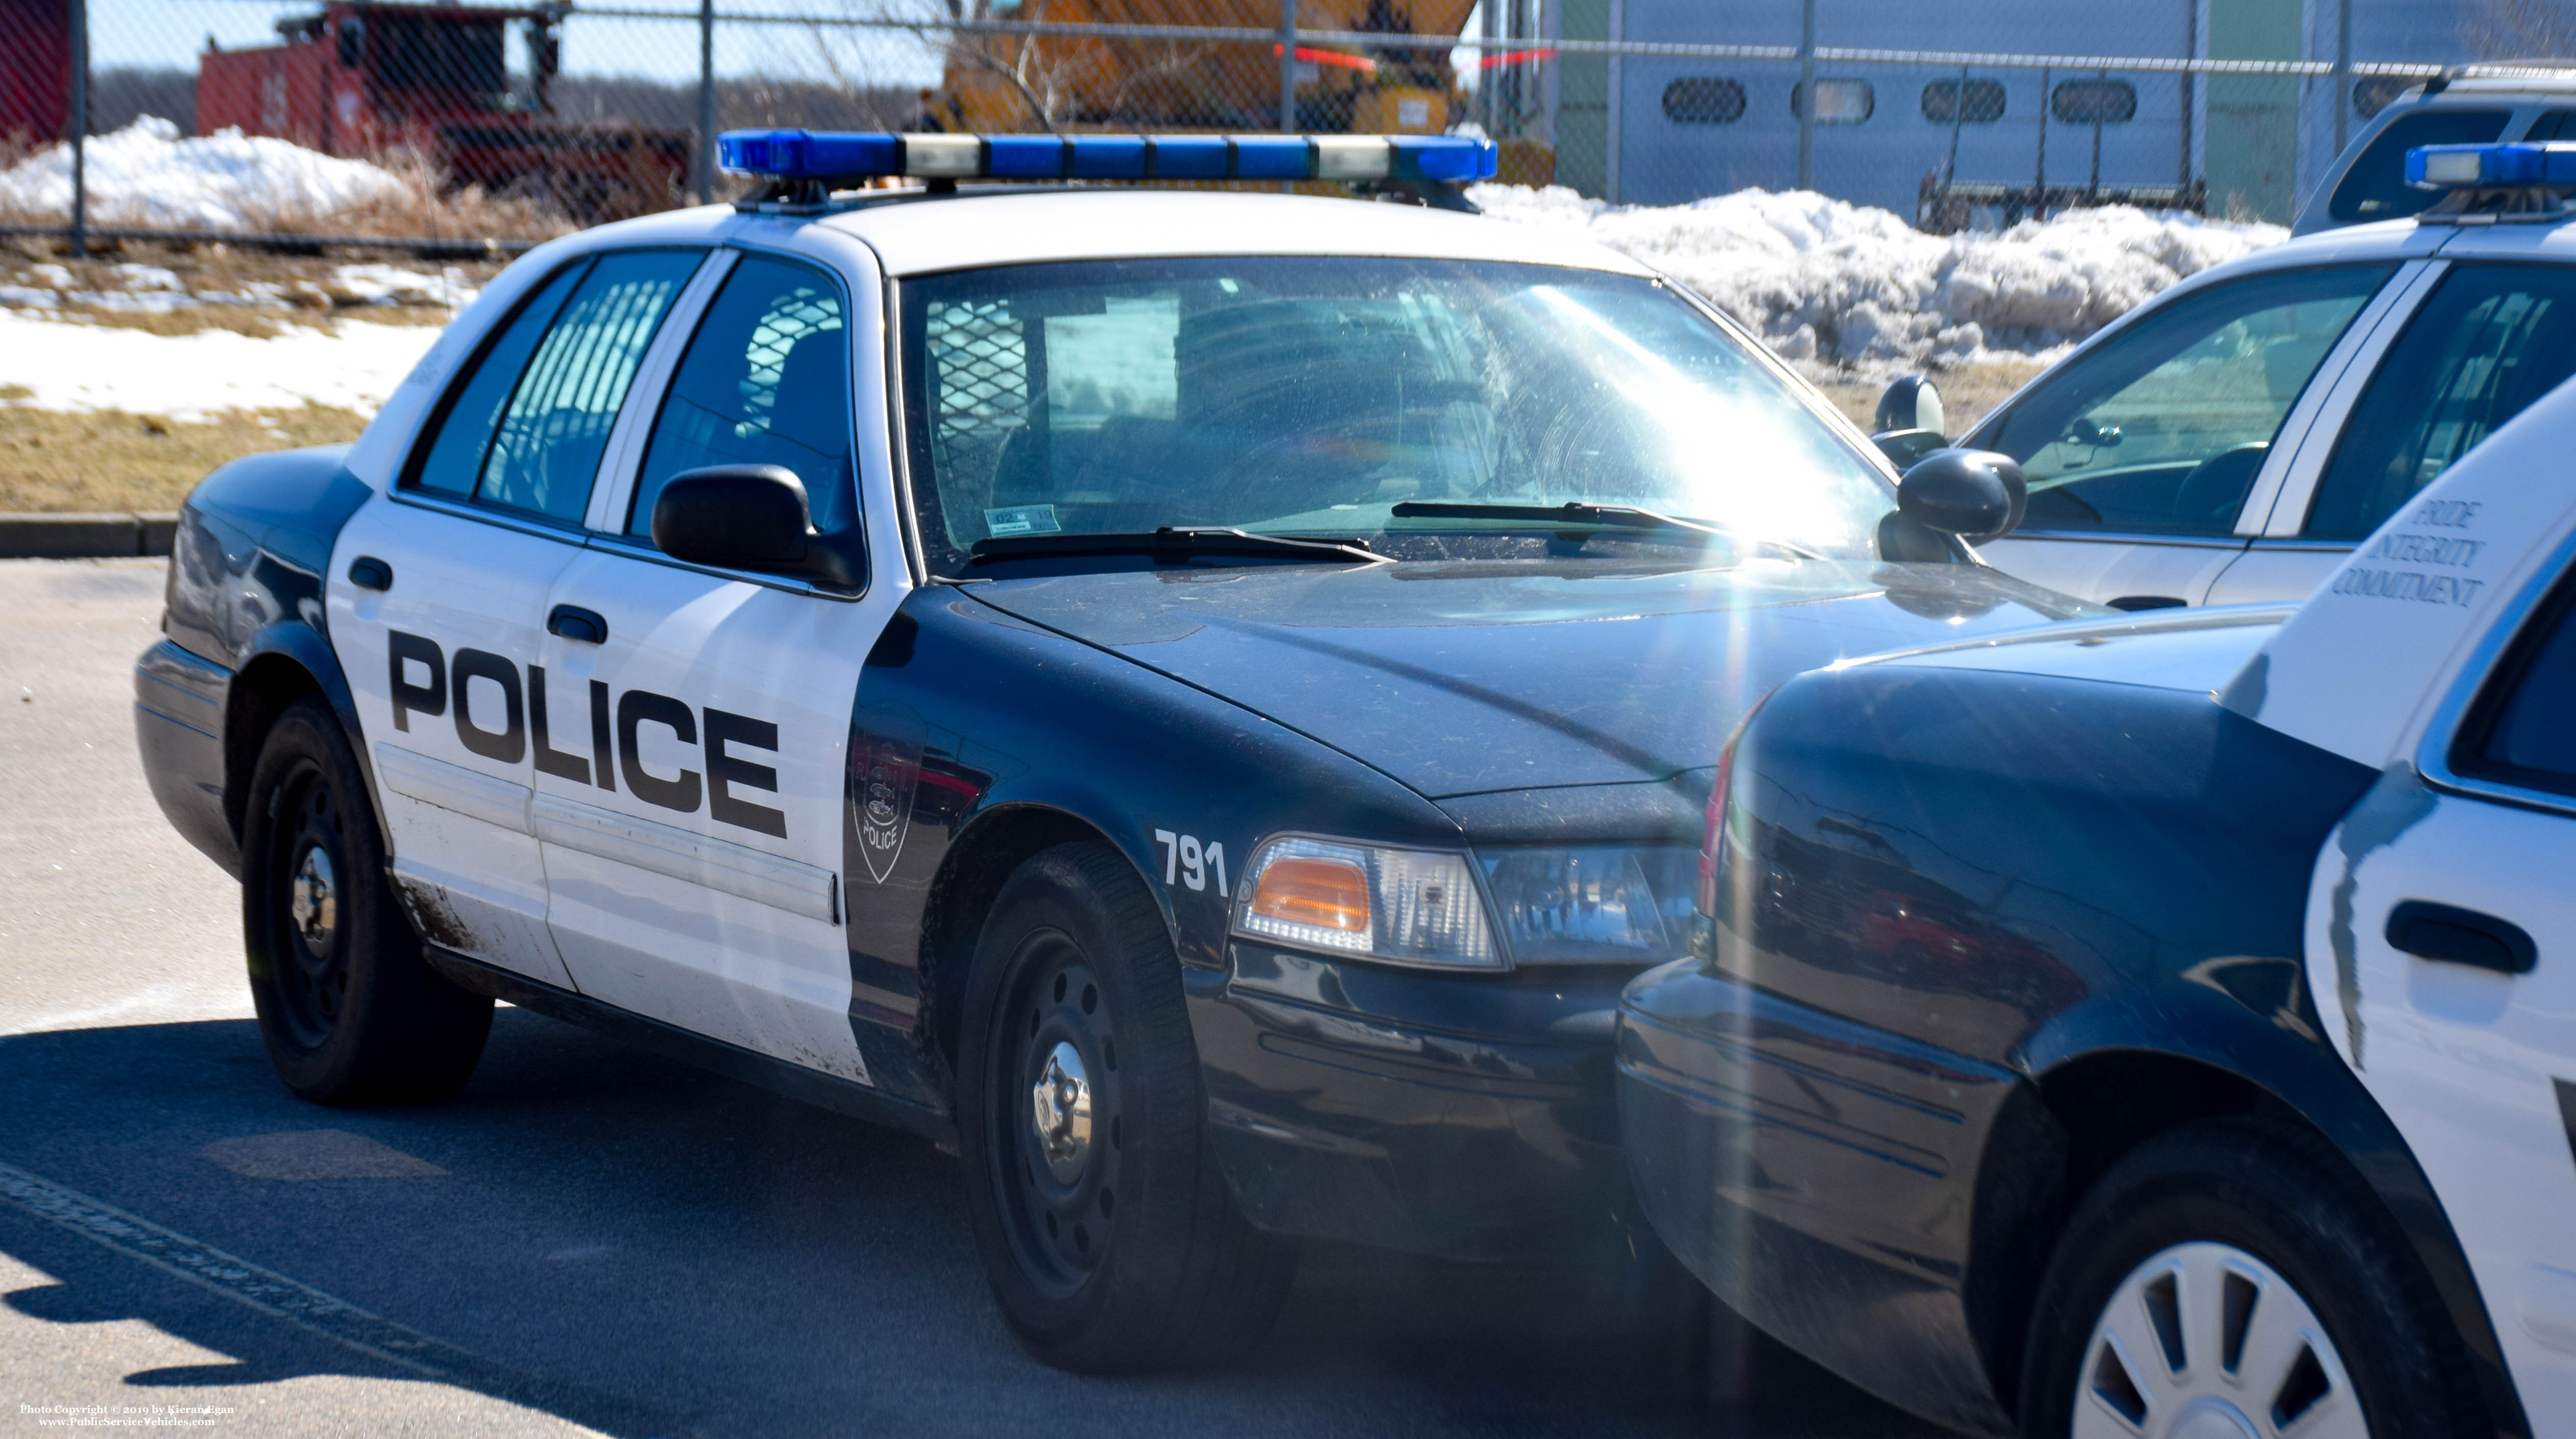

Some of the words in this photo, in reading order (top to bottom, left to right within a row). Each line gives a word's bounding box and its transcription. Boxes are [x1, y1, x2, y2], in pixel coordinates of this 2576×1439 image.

[996, 513, 1012, 523] 02
[388, 628, 788, 840] POLICE
[863, 816, 898, 850] POLICE
[1155, 828, 1228, 898] 791
